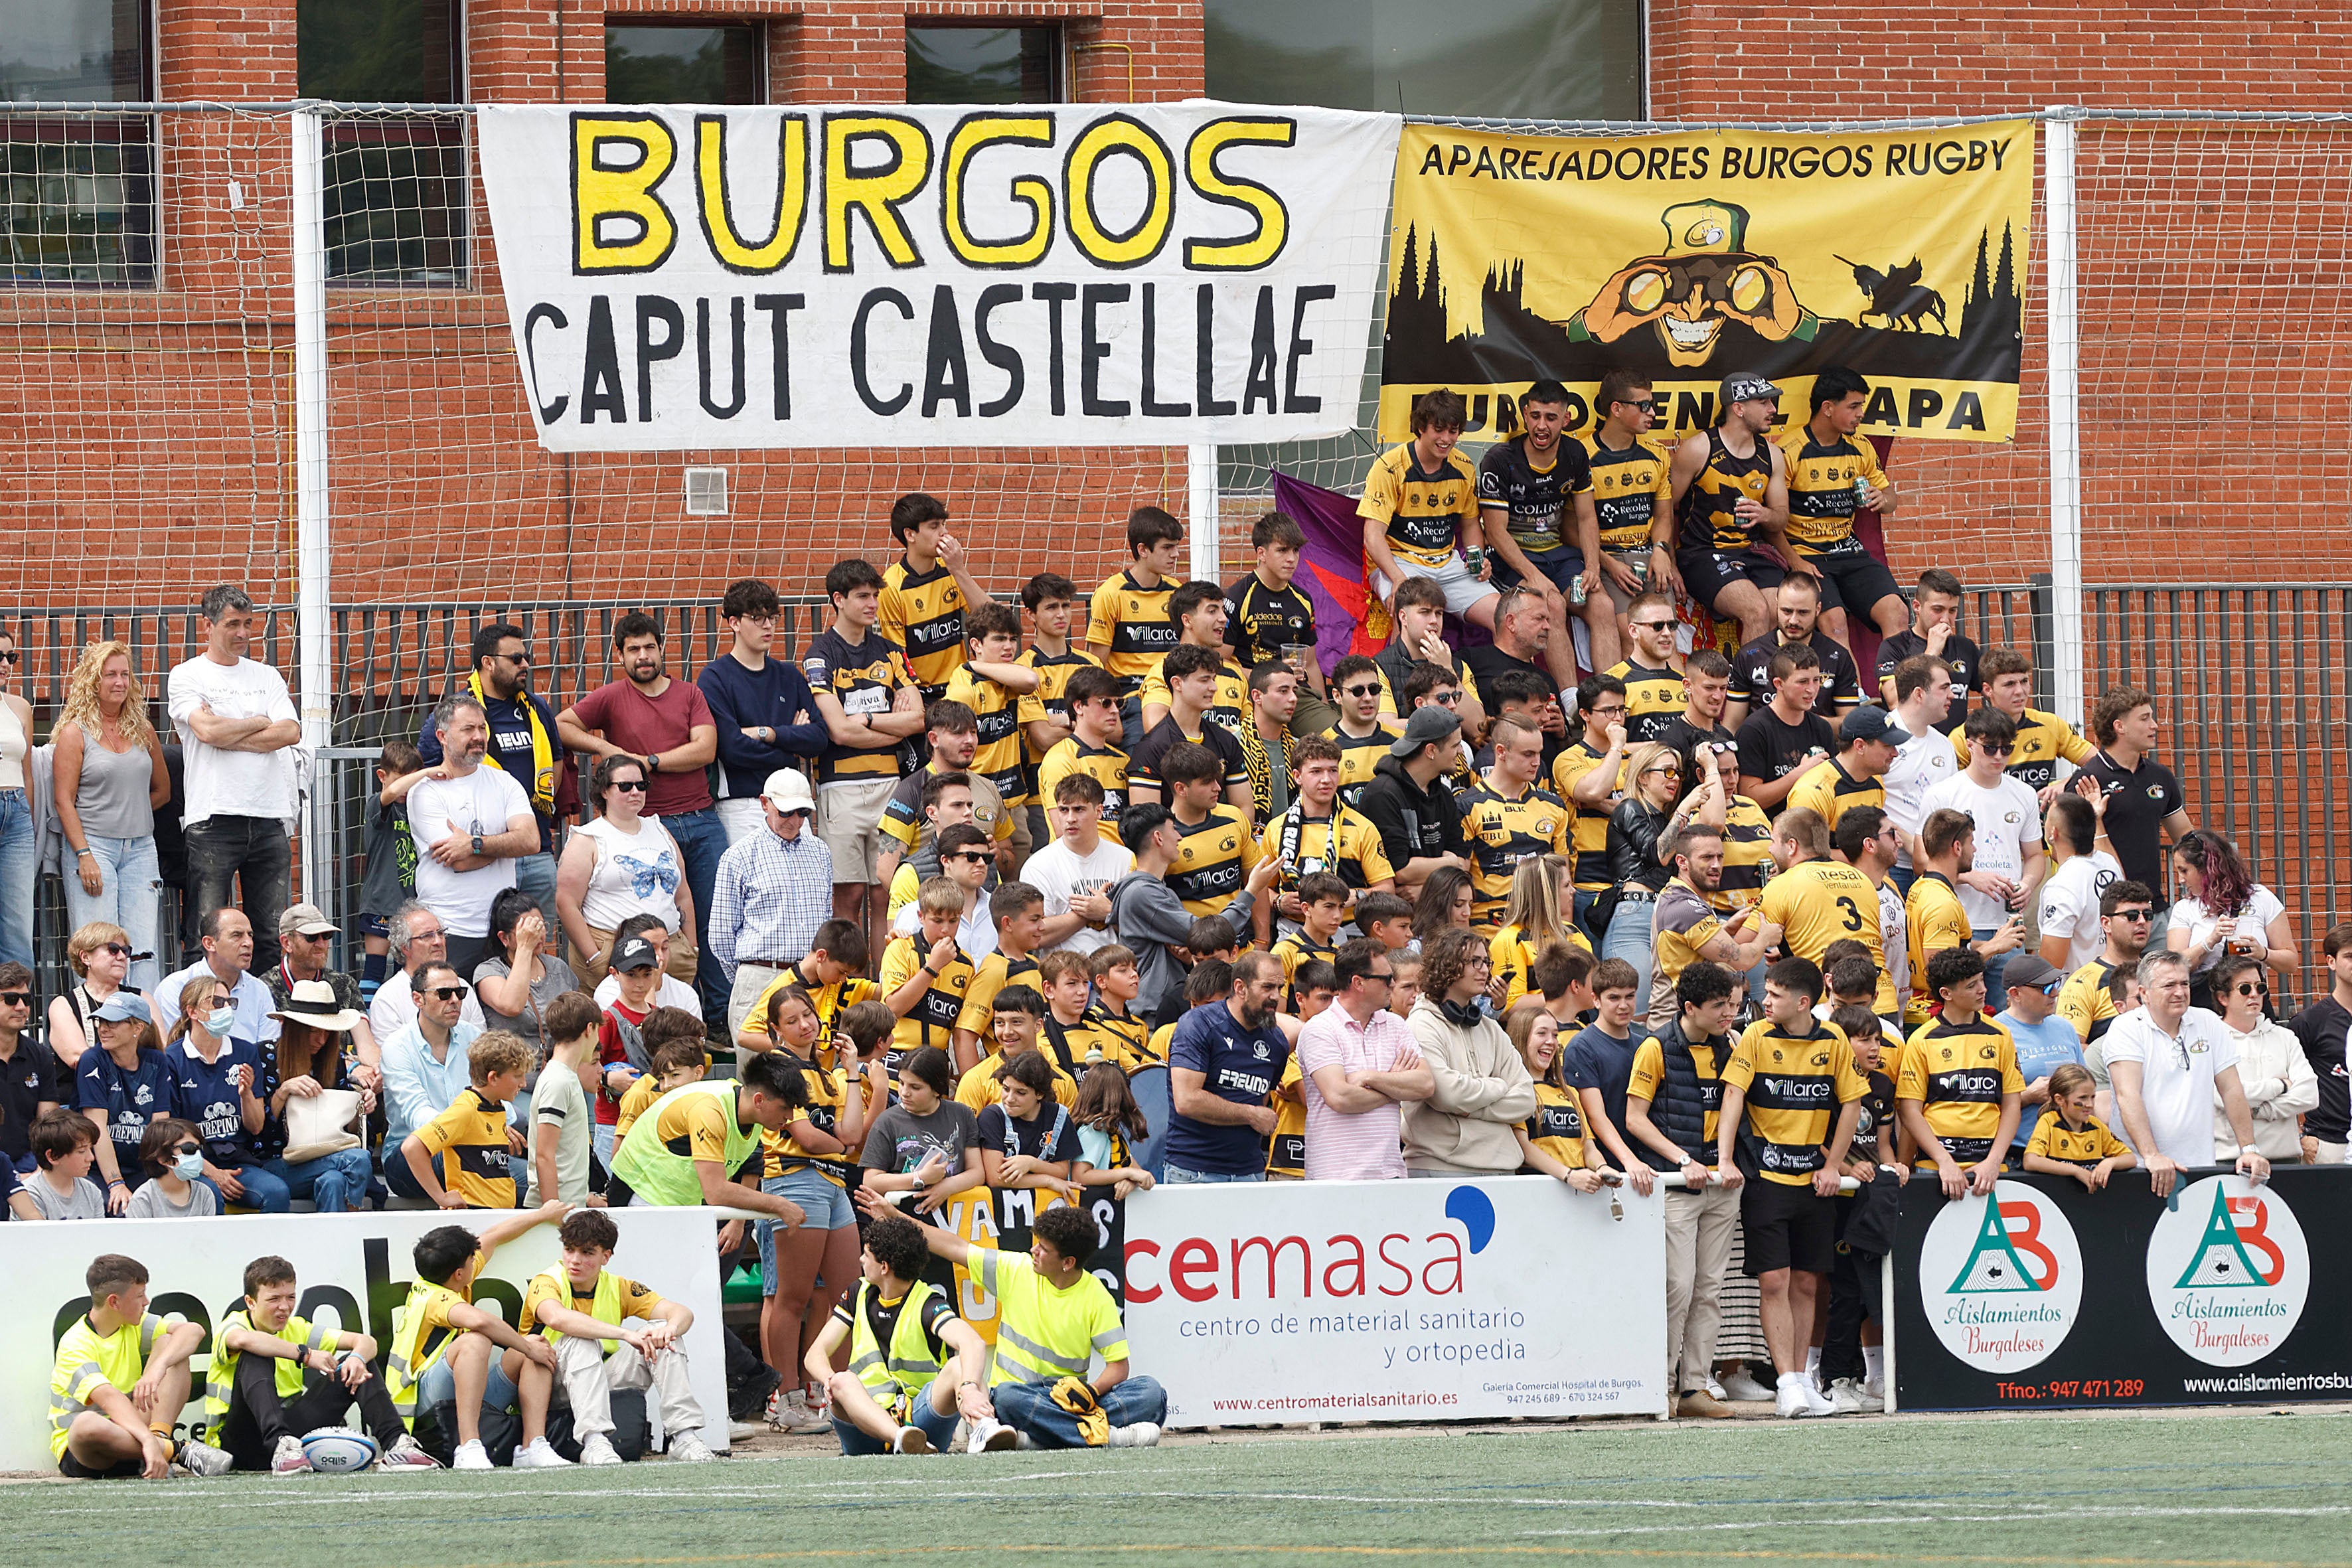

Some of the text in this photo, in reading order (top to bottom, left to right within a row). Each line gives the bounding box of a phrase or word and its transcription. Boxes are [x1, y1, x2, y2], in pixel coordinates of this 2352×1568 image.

[1419, 137, 2013, 181] APAREJADORES BURGOS RUGBY
[570, 110, 1298, 276] BURGOS
[524, 280, 1336, 425] CAPUT CASTELLAE
[1861, 387, 1988, 433] APA
[842, 668, 857, 678] BLK
[1481, 832, 1504, 842] UBU
[1816, 868, 1863, 880] itesal
[1836, 896, 1862, 931] 3
[626, 939, 643, 951] NIKE
[1218, 1069, 1270, 1095] FREUND
[1764, 1078, 1829, 1096] Villarce
[1123, 1232, 1462, 1303] cemasa
[1943, 1297, 2062, 1325] Aislamientos
[2171, 1292, 2288, 1319] Aislamientos
[1180, 1307, 1526, 1338] centro de material sanitario
[1960, 1325, 2045, 1361] Burgaleses
[2189, 1319, 2270, 1355] Burgaleses
[1383, 1339, 1526, 1369] y ortopedia
[1482, 1378, 1644, 1393] Galería Comercial Hospital de Burgos.
[1507, 1395, 1524, 1404] 947
[1525, 1395, 1541, 1403] 245
[1543, 1394, 1560, 1403] 689
[1569, 1393, 1585, 1402] 670
[1587, 1392, 1603, 1401] 324
[1605, 1391, 1620, 1400] 567
[1996, 1379, 2144, 1399] Tfno.: 947 471 289
[1213, 1390, 1458, 1412] www.centromaterialsanitario.es
